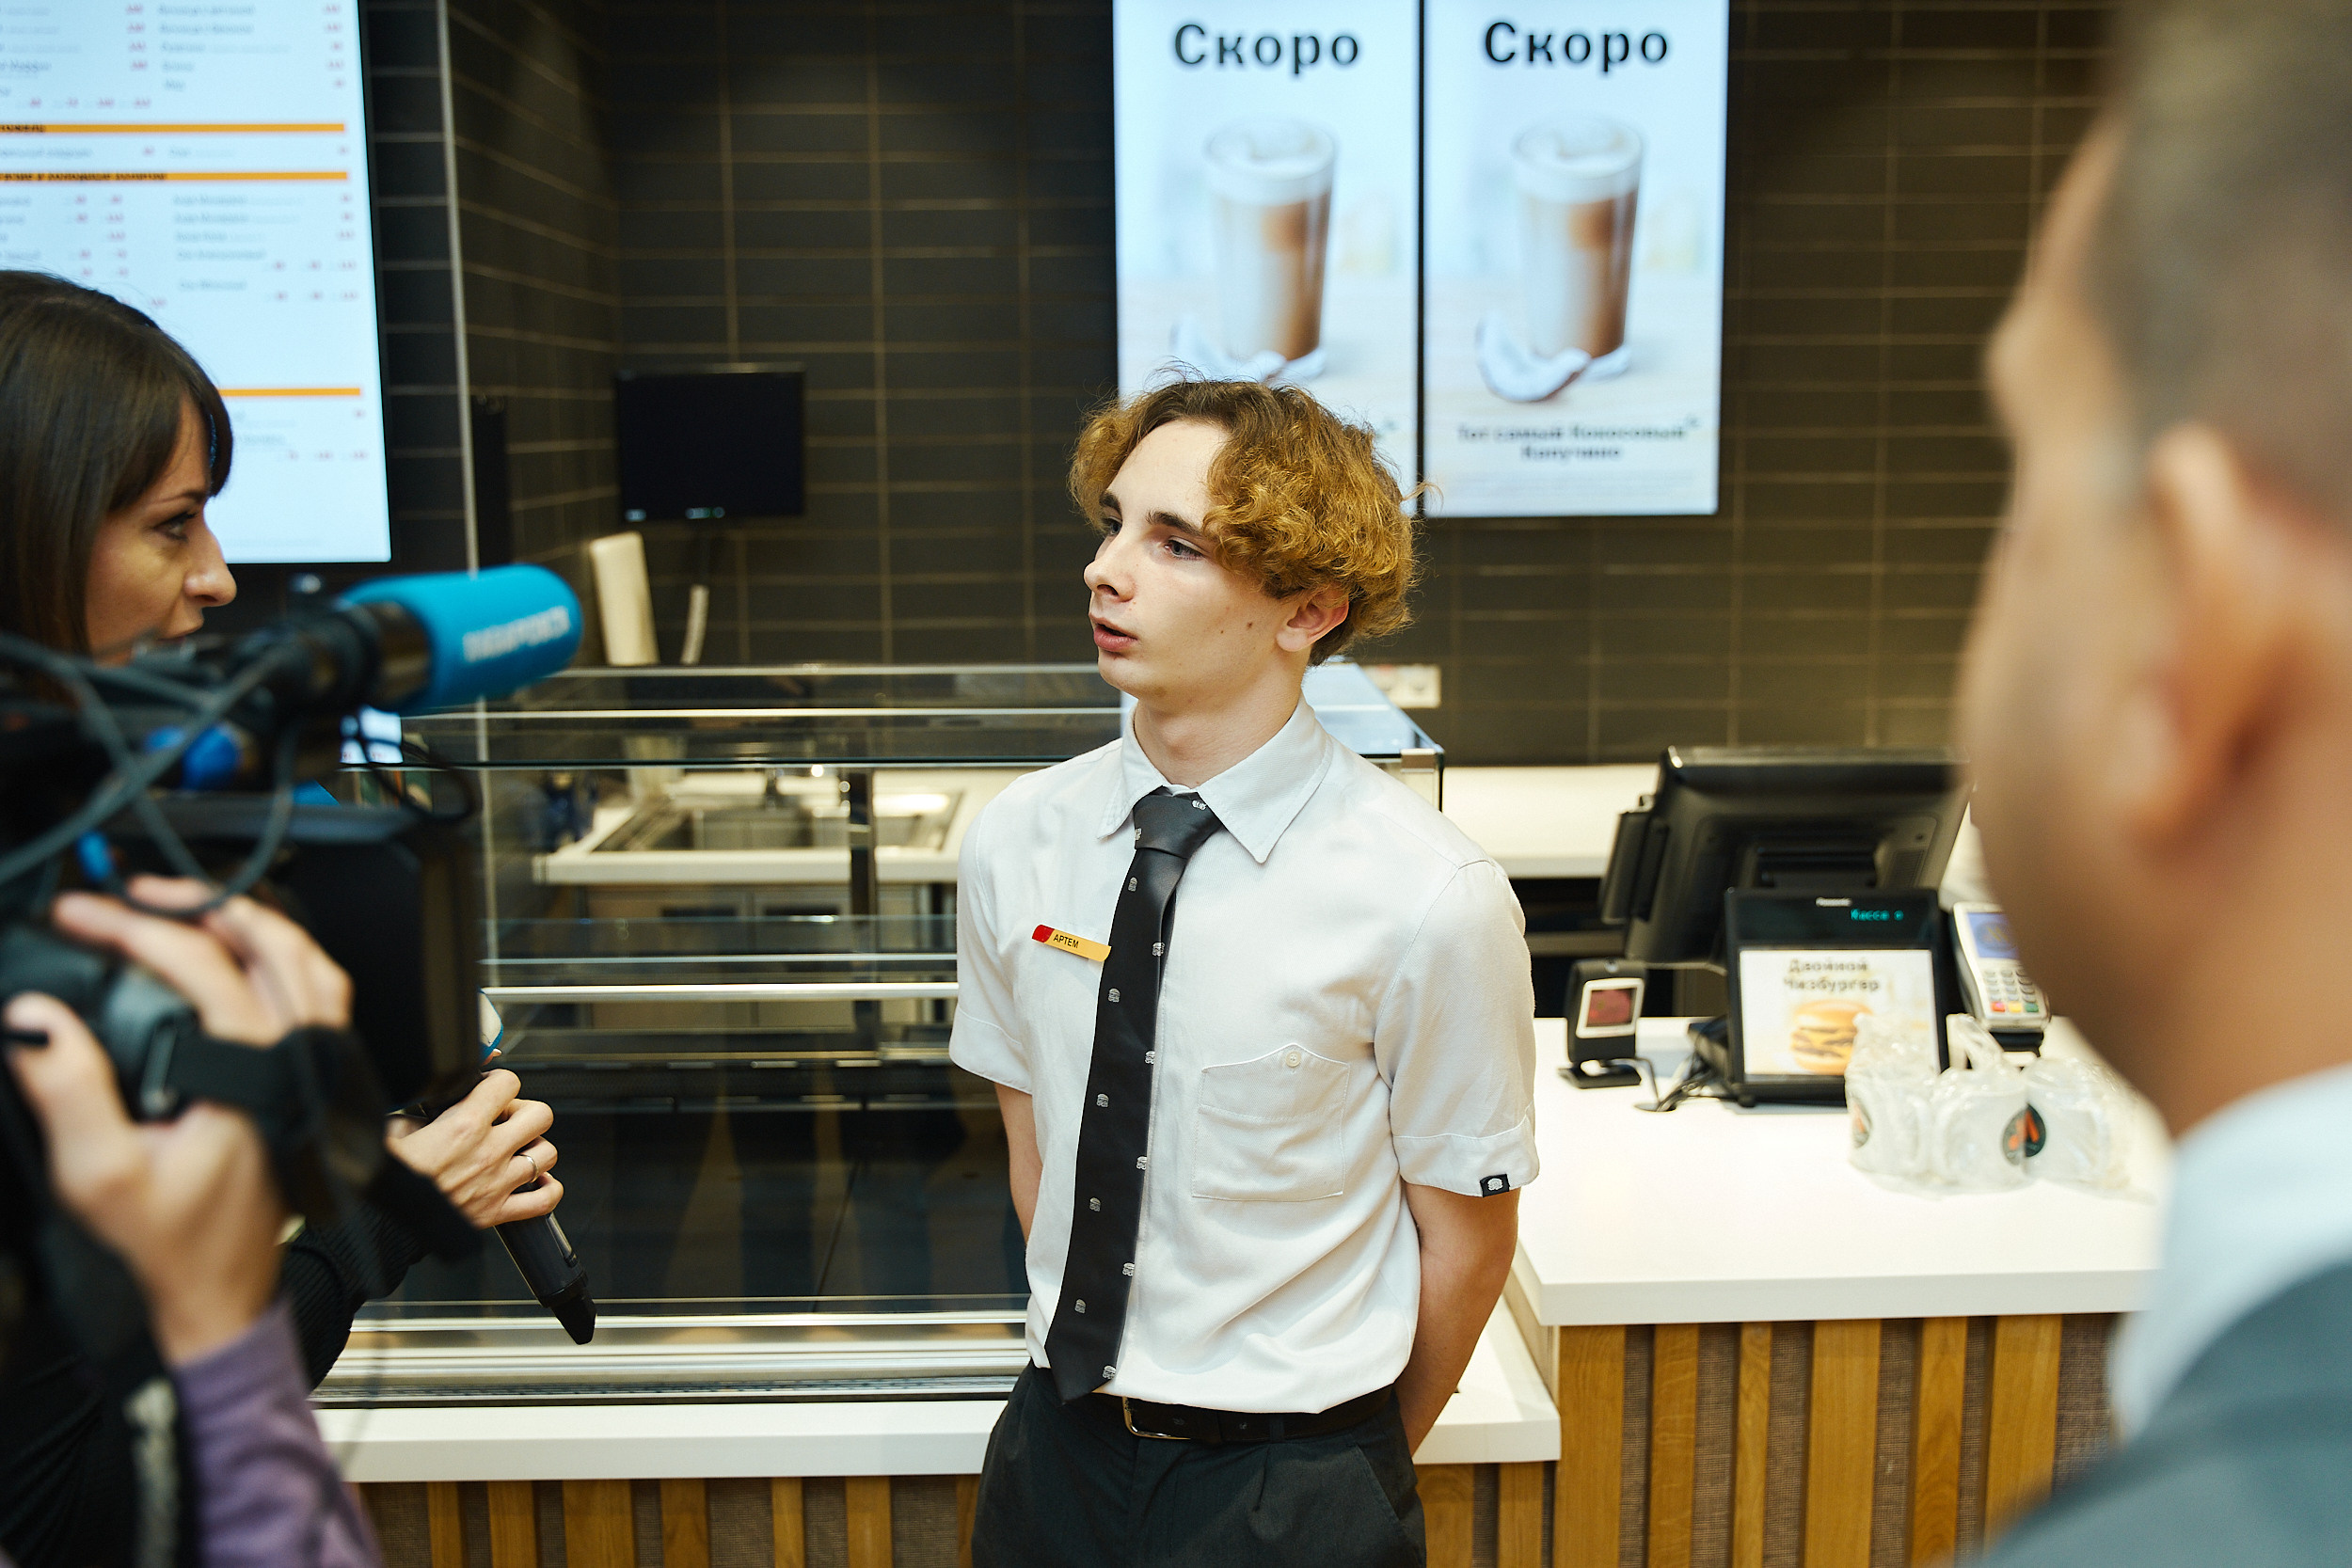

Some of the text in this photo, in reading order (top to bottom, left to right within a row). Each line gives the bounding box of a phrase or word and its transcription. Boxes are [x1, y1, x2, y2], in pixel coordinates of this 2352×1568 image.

[1173, 23, 1360, 76] Скоро
[1483, 21, 1670, 74] Скоро
[1053, 934, 1079, 949] АРТЕМ
